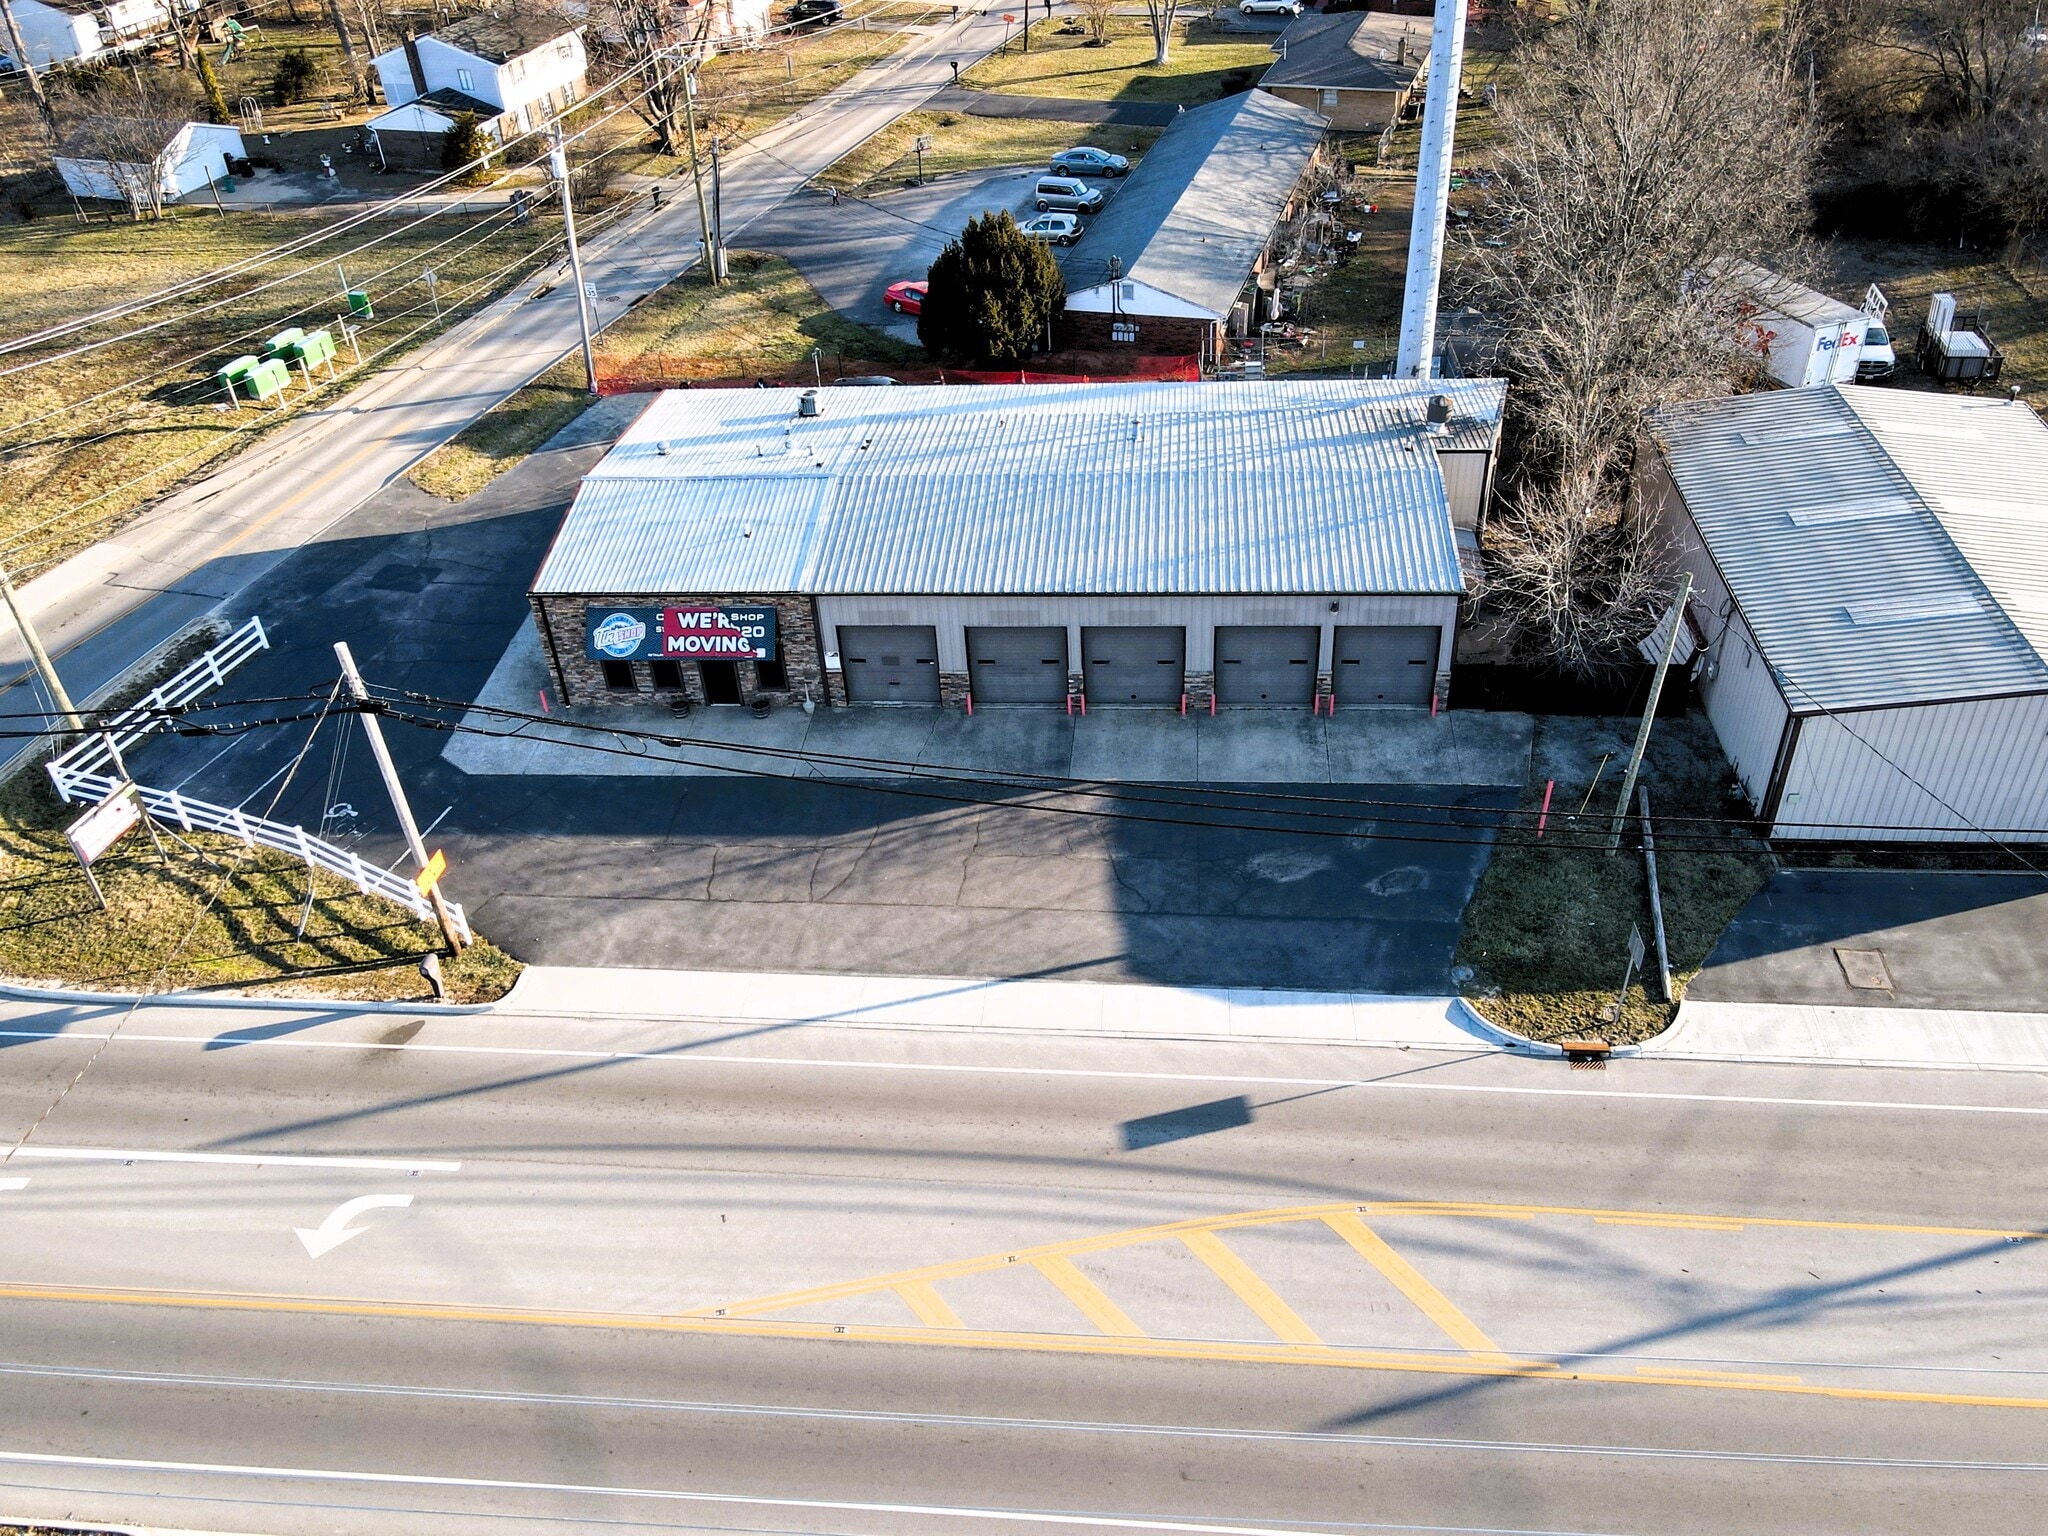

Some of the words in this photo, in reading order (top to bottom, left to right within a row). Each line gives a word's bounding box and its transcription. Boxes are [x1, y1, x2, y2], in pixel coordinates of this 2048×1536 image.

[1816, 332, 1858, 351] FedEx
[677, 612, 735, 629] WE'R
[731, 613, 764, 621] SHOP
[616, 627, 643, 641] SHOP
[667, 636, 751, 652] MOVING
